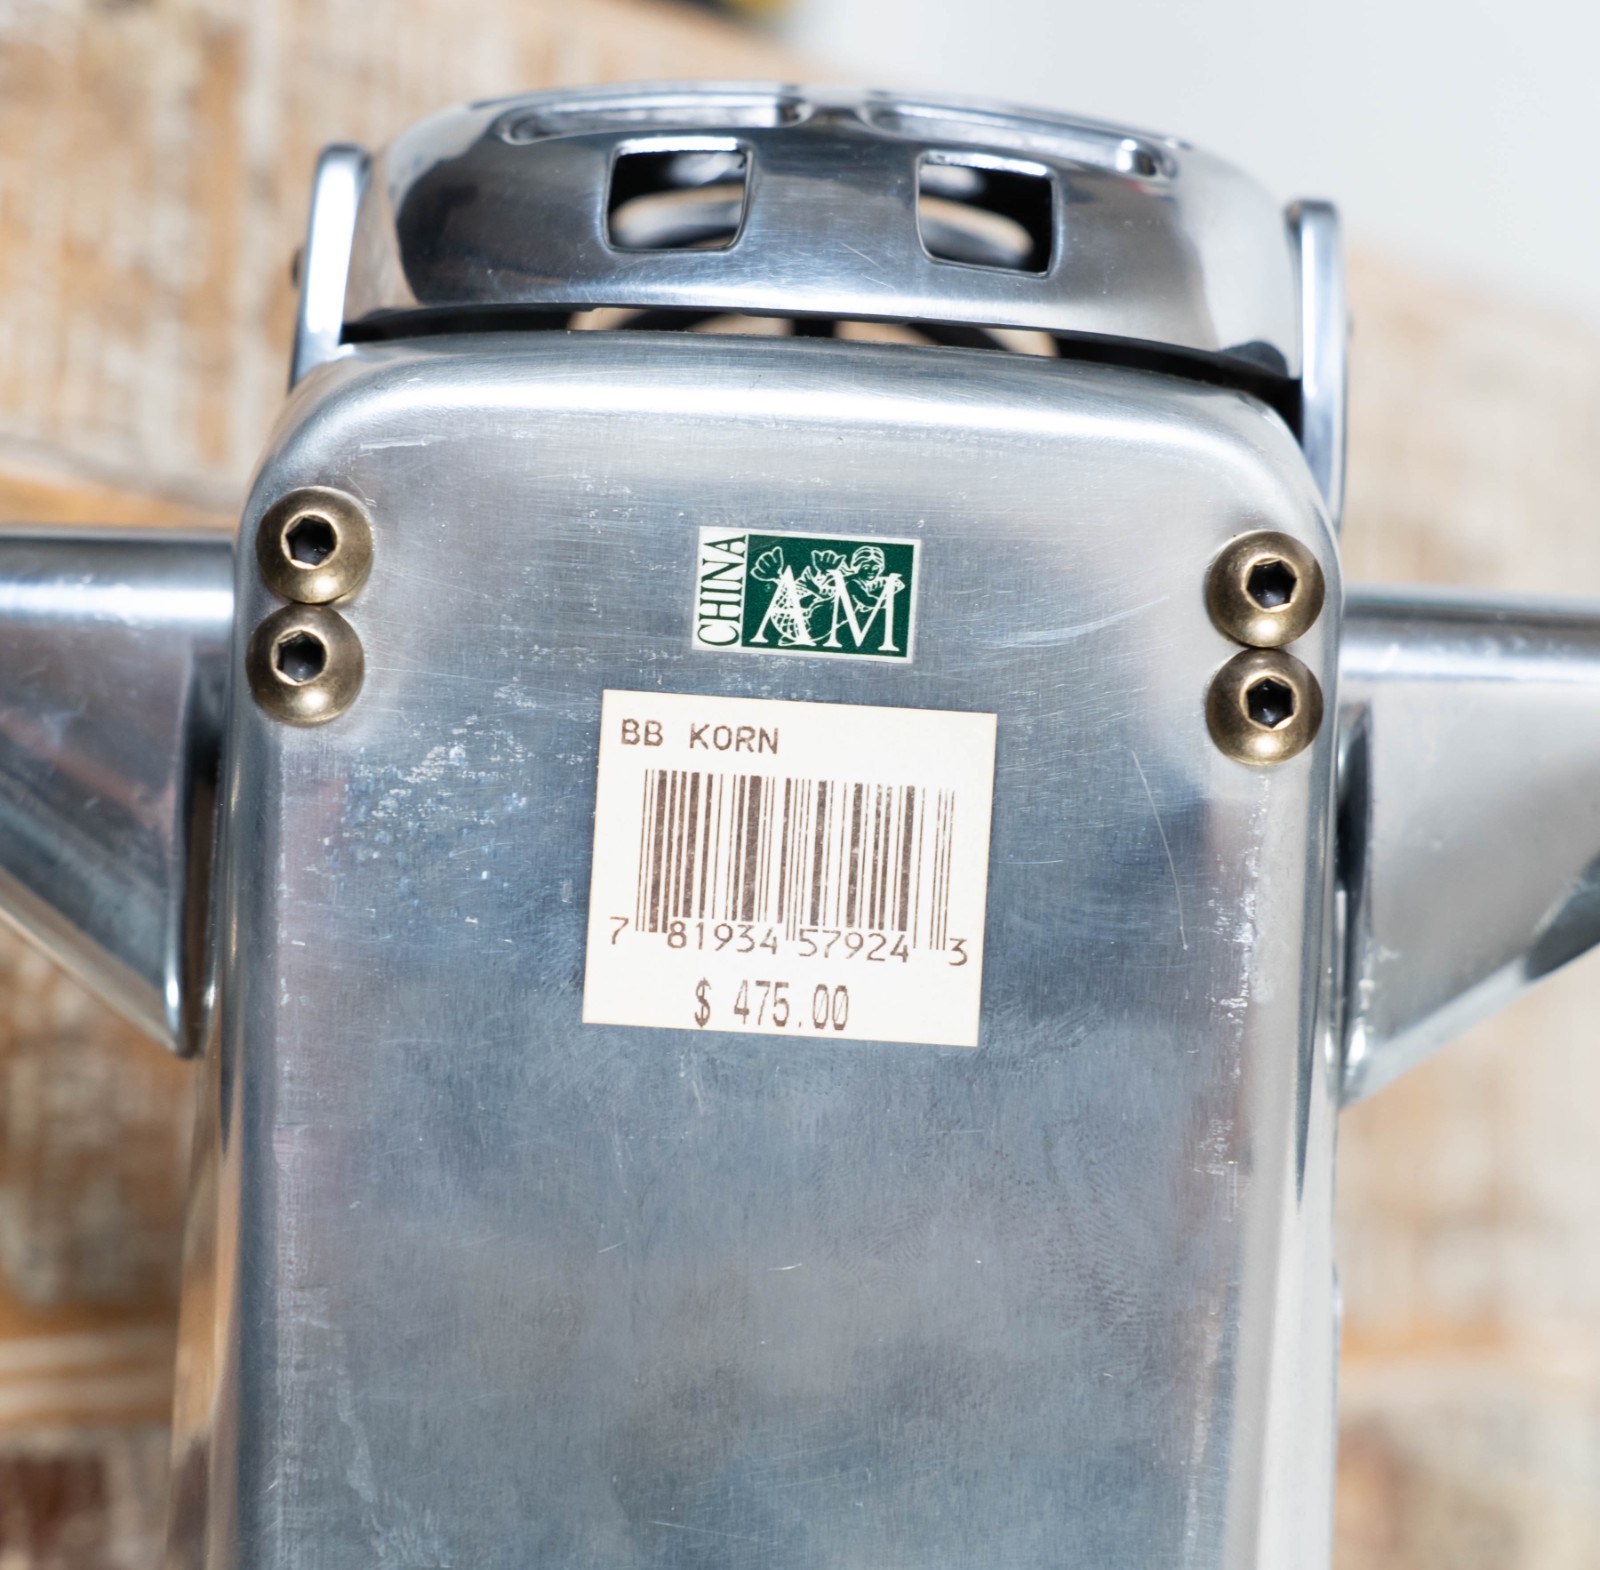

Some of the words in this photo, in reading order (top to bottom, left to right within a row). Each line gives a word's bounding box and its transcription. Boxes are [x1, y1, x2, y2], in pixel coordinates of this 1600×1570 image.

[697, 534, 747, 647] CHINA
[749, 564, 903, 652] AM
[620, 718, 664, 747] BB
[689, 722, 779, 755] KORN
[609, 916, 630, 946] 7
[667, 921, 779, 955] 81934
[798, 928, 910, 963] 57924
[948, 937, 969, 966] 3
[733, 979, 850, 1032] 475.00
